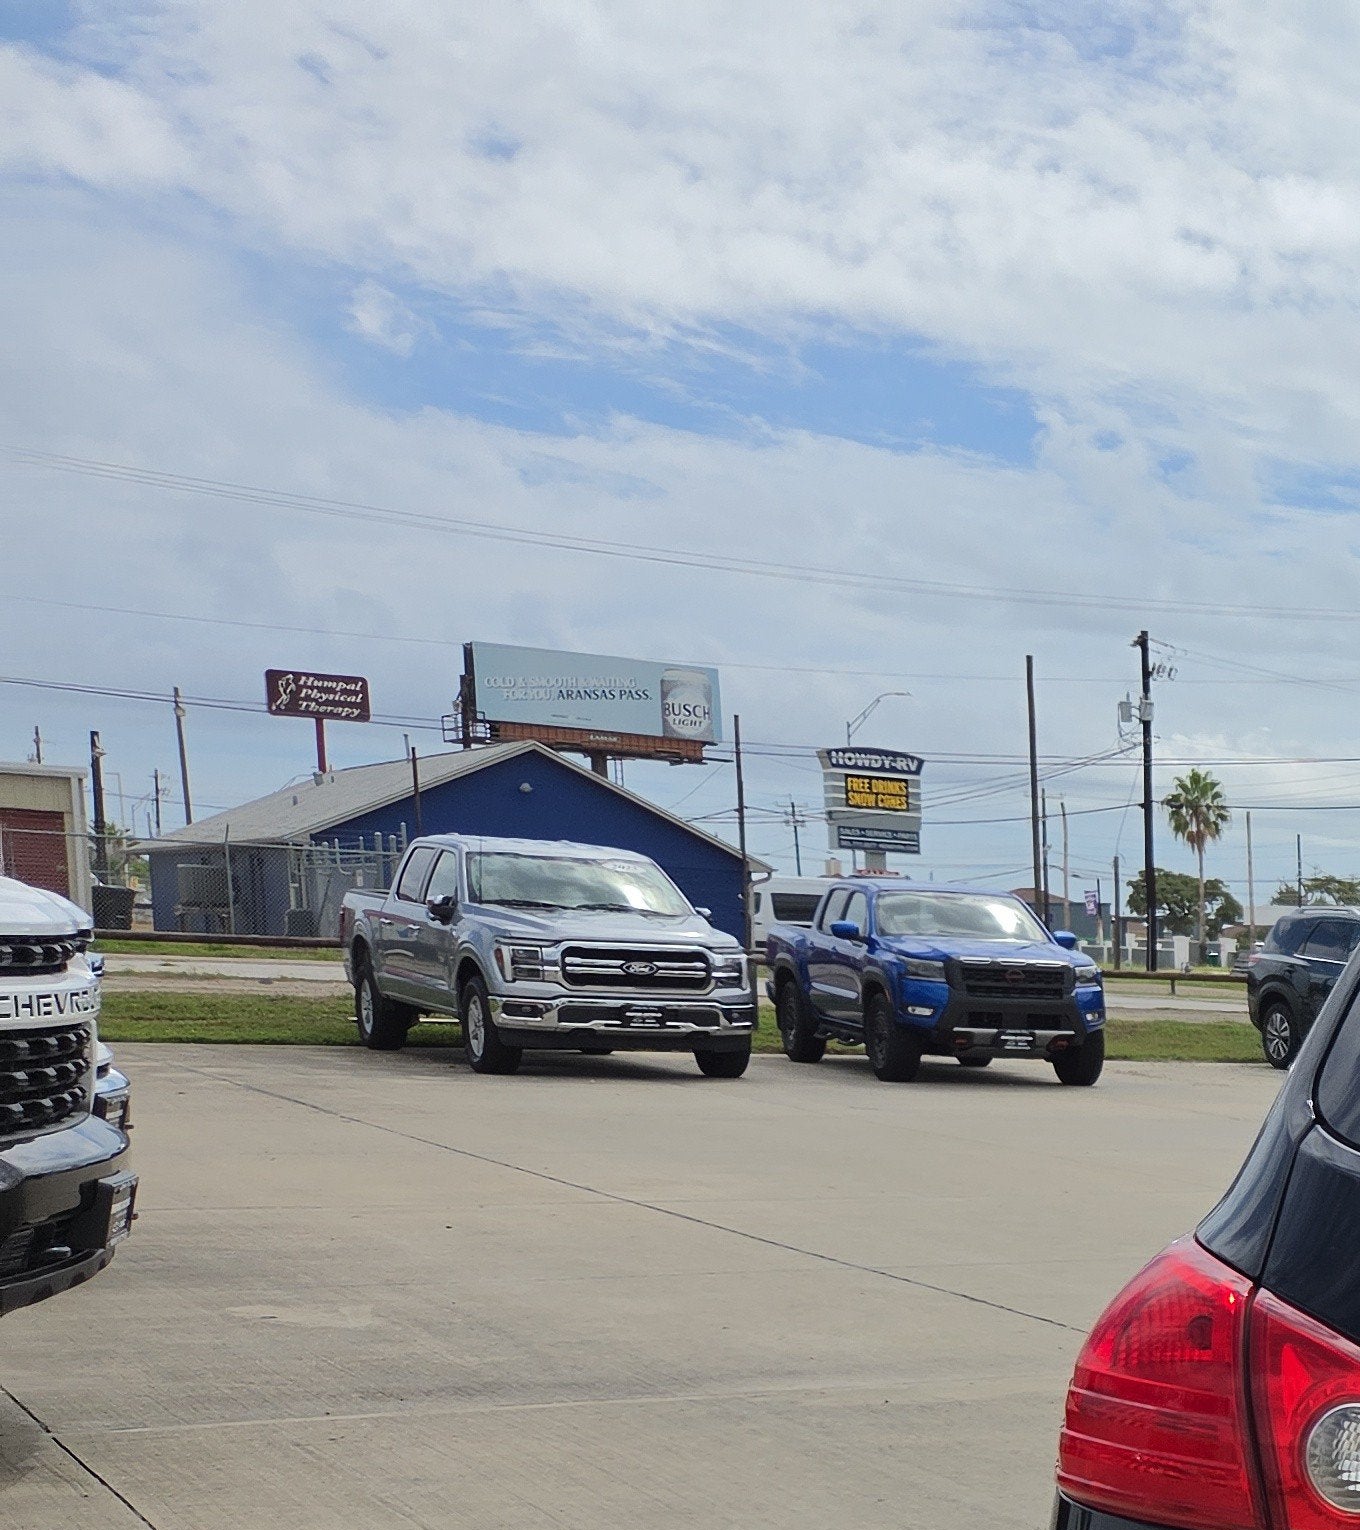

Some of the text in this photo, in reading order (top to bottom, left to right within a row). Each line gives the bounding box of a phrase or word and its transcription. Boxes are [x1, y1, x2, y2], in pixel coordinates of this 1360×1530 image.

[298, 676, 362, 691] Humpal
[300, 688, 363, 703] Physical
[557, 688, 615, 700] ARANSAS
[618, 689, 653, 701] PASS.
[299, 700, 361, 717] Therapy
[664, 702, 711, 720] BUSCH
[672, 718, 703, 727] LIGHT
[847, 777, 870, 793] FREE
